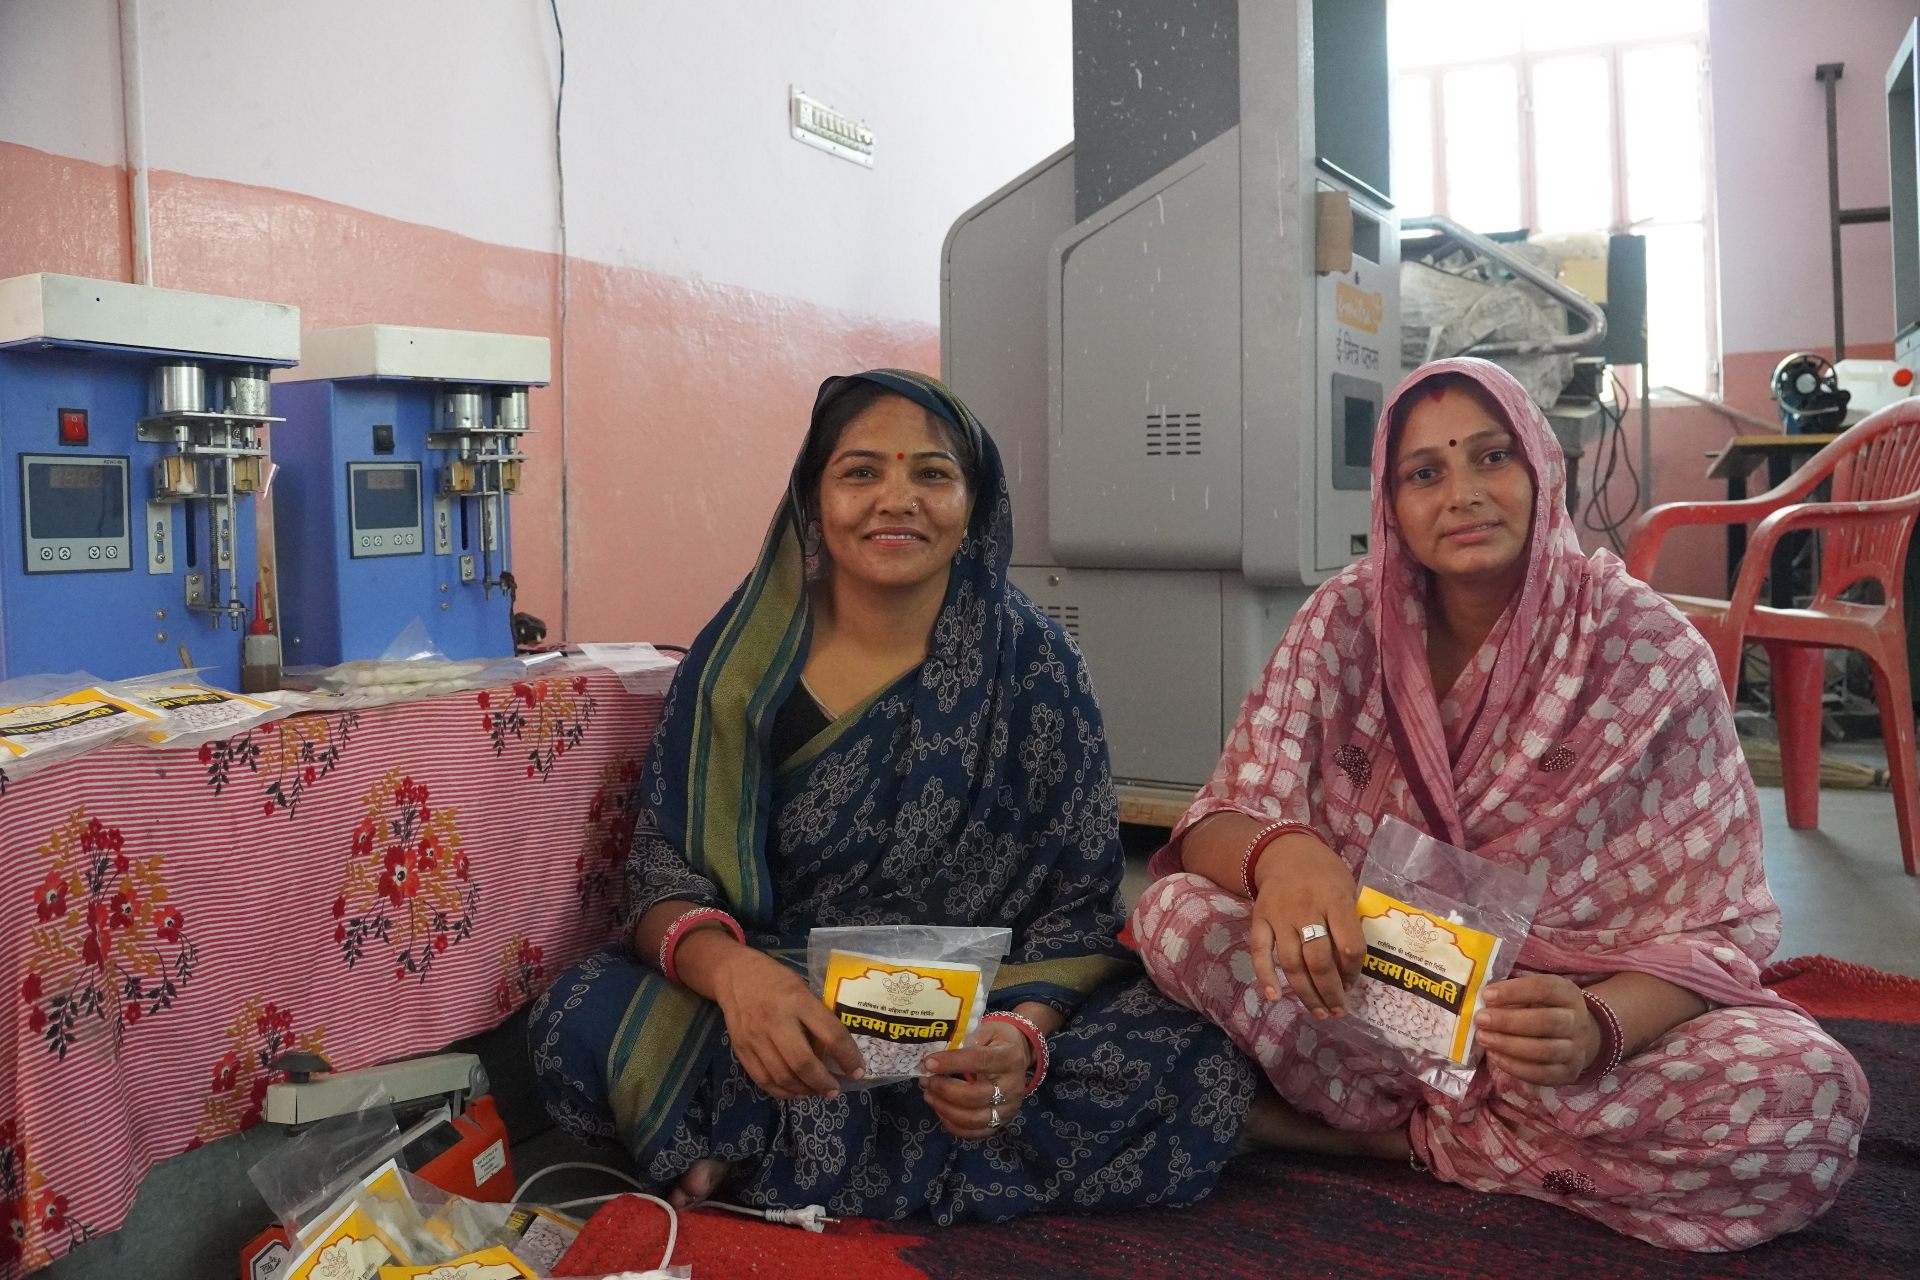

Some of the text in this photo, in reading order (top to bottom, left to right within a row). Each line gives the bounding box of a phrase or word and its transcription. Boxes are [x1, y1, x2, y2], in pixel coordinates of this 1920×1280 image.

[1402, 967, 1458, 1005] फुलबत्ति
[841, 1012, 949, 1041] परचम फुलबत्ति
